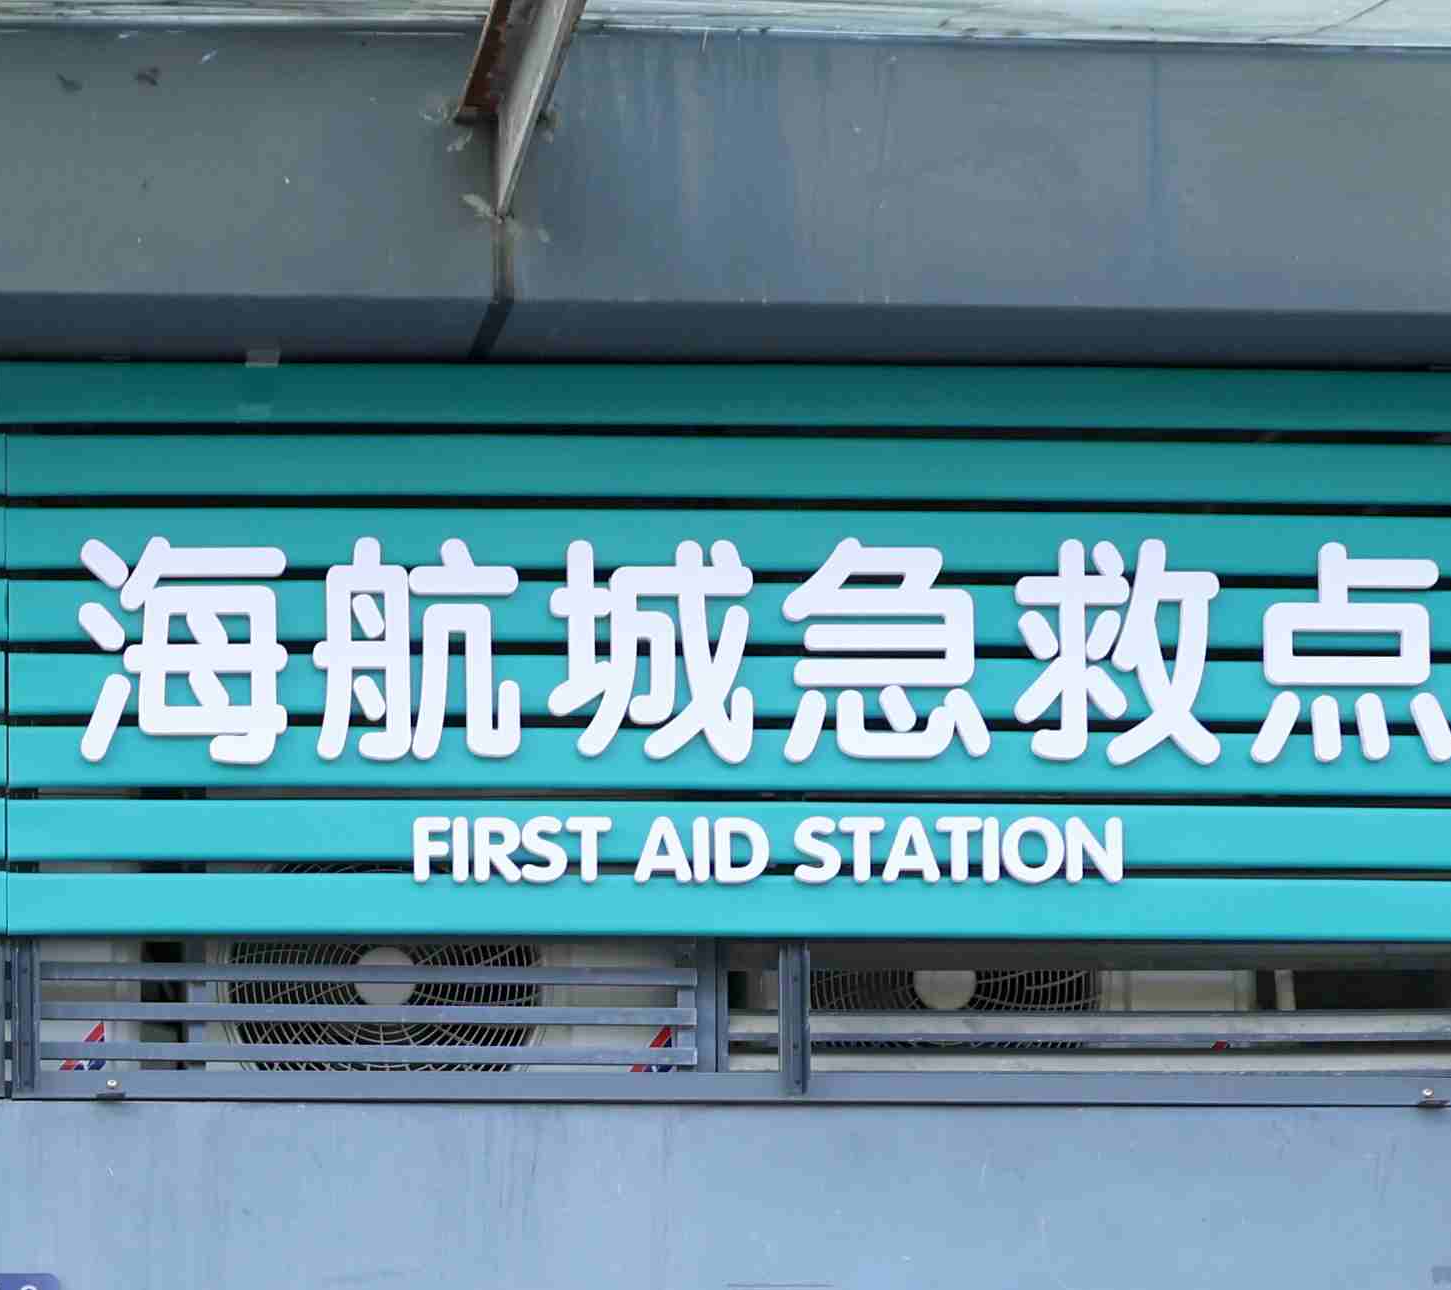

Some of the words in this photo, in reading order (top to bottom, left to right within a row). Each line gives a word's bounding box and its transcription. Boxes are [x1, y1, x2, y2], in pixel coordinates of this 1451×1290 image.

[413, 816, 612, 884] FIRST
[634, 816, 770, 884] AID
[793, 816, 1124, 885] STATION
